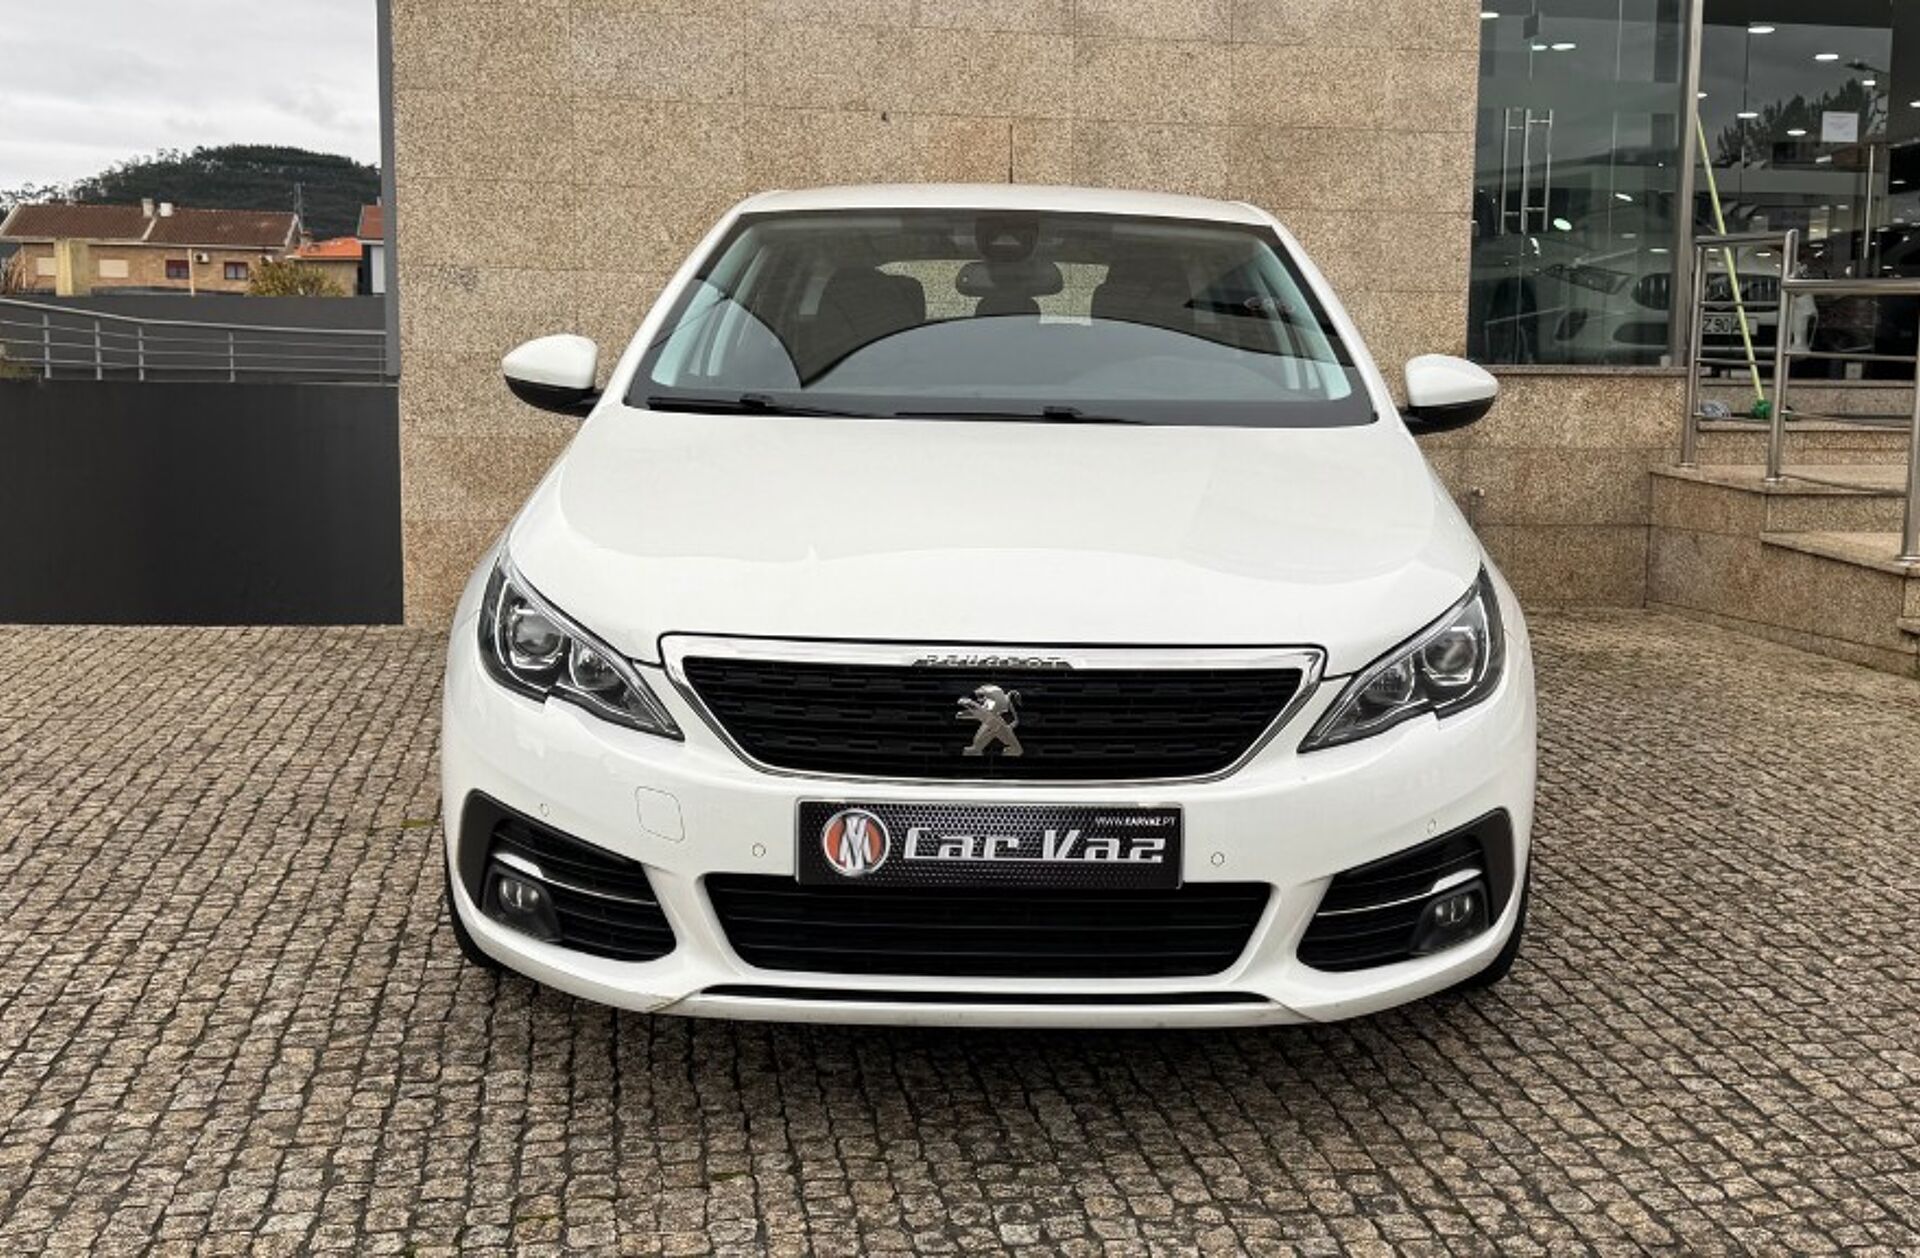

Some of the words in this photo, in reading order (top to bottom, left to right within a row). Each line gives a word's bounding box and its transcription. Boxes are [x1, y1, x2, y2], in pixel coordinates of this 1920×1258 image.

[926, 654, 1062, 669] PEUGEOT
[903, 827, 1019, 861] Car
[1042, 829, 1166, 864] Vaz
